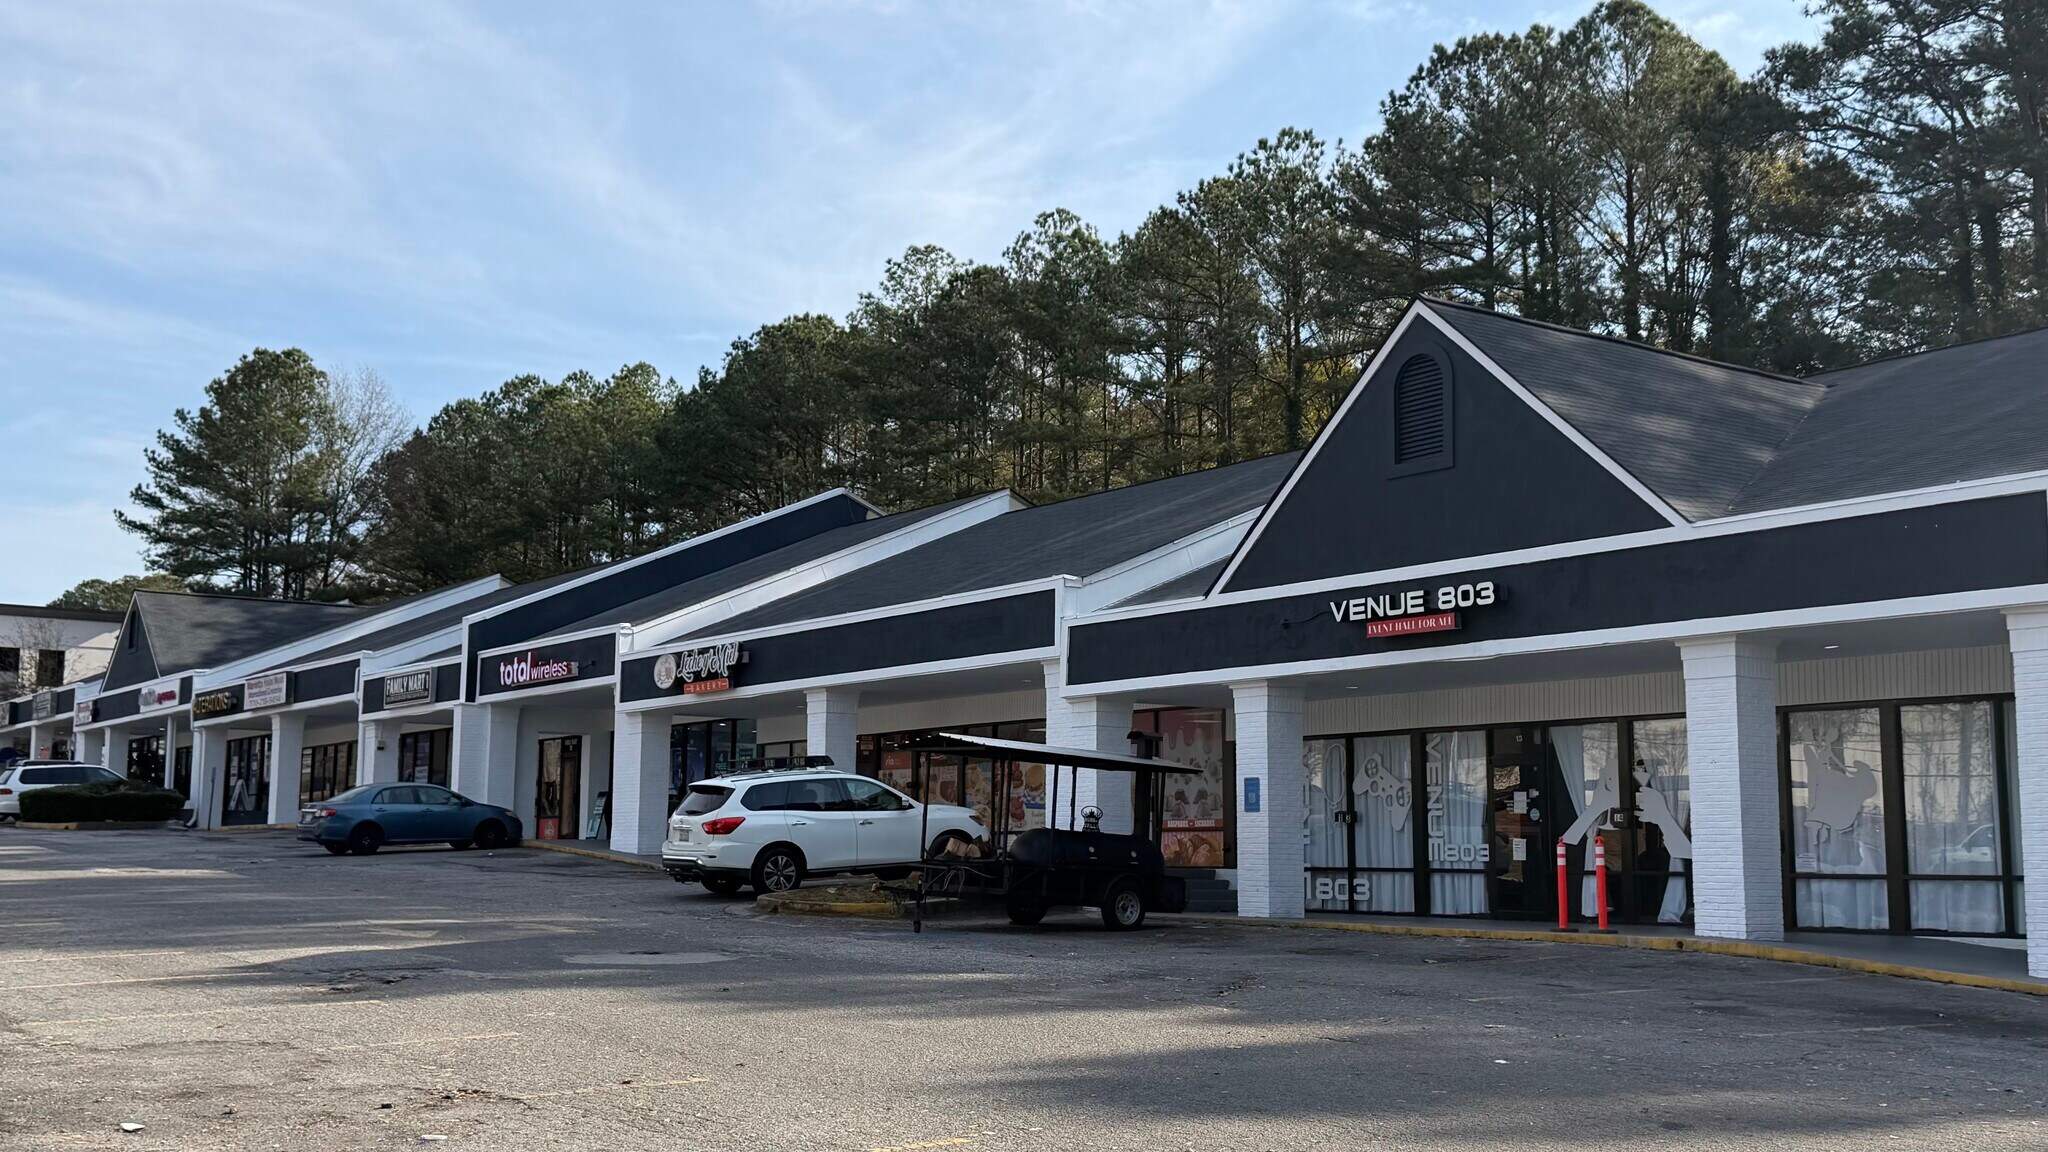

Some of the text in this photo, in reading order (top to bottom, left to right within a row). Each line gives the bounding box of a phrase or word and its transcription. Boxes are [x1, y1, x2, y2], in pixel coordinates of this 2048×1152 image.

[1329, 581, 1495, 622] VENUE 803
[1368, 616, 1452, 635] EVENT HALL FOR ALL
[500, 651, 568, 686] total wireless
[386, 677, 407, 696] FAMILY
[408, 673, 426, 692] MART
[689, 682, 722, 693] BAKERY
[1426, 734, 1445, 861] VENUE
[1315, 877, 1372, 901] 803
